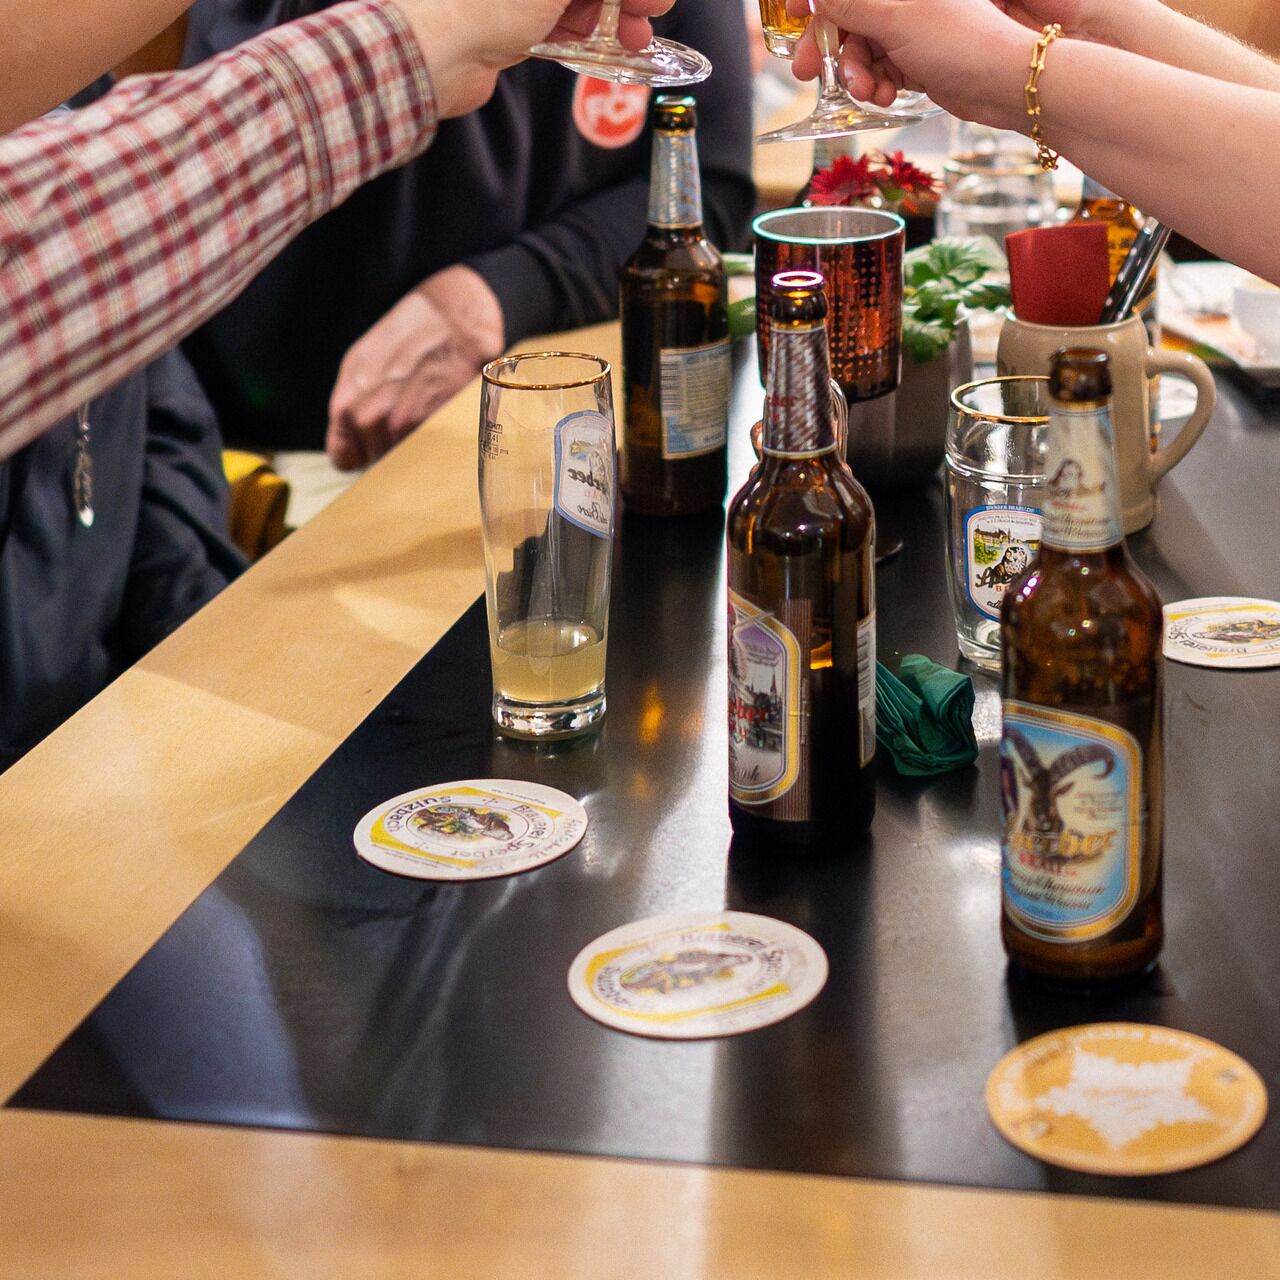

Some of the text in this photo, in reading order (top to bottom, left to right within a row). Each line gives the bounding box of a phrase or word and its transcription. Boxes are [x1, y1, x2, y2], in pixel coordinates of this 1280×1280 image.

[386, 795, 453, 833] Sulzbach
[512, 802, 547, 842] Brauerei
[451, 838, 536, 858] Sperber
